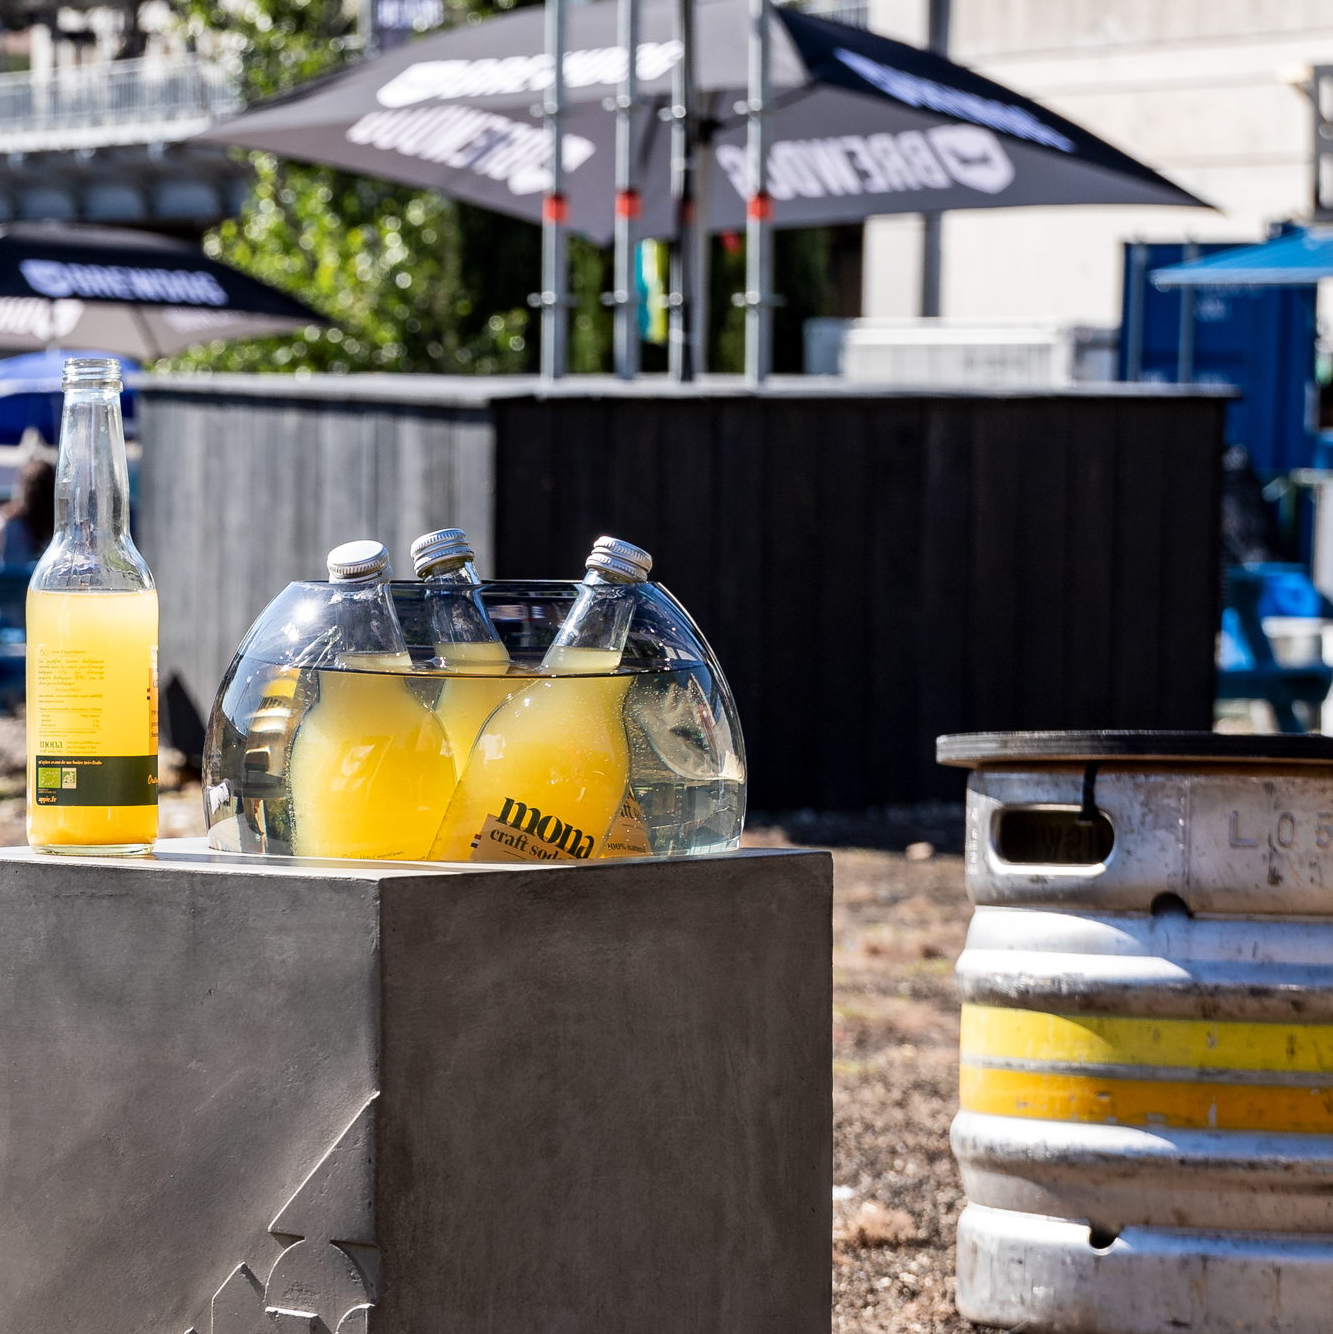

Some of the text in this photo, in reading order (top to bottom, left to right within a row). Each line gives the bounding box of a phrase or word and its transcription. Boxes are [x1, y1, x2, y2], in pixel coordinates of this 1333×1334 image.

[39, 740, 63, 748] mona
[495, 796, 595, 859] mona
[490, 829, 563, 860] craft sod
